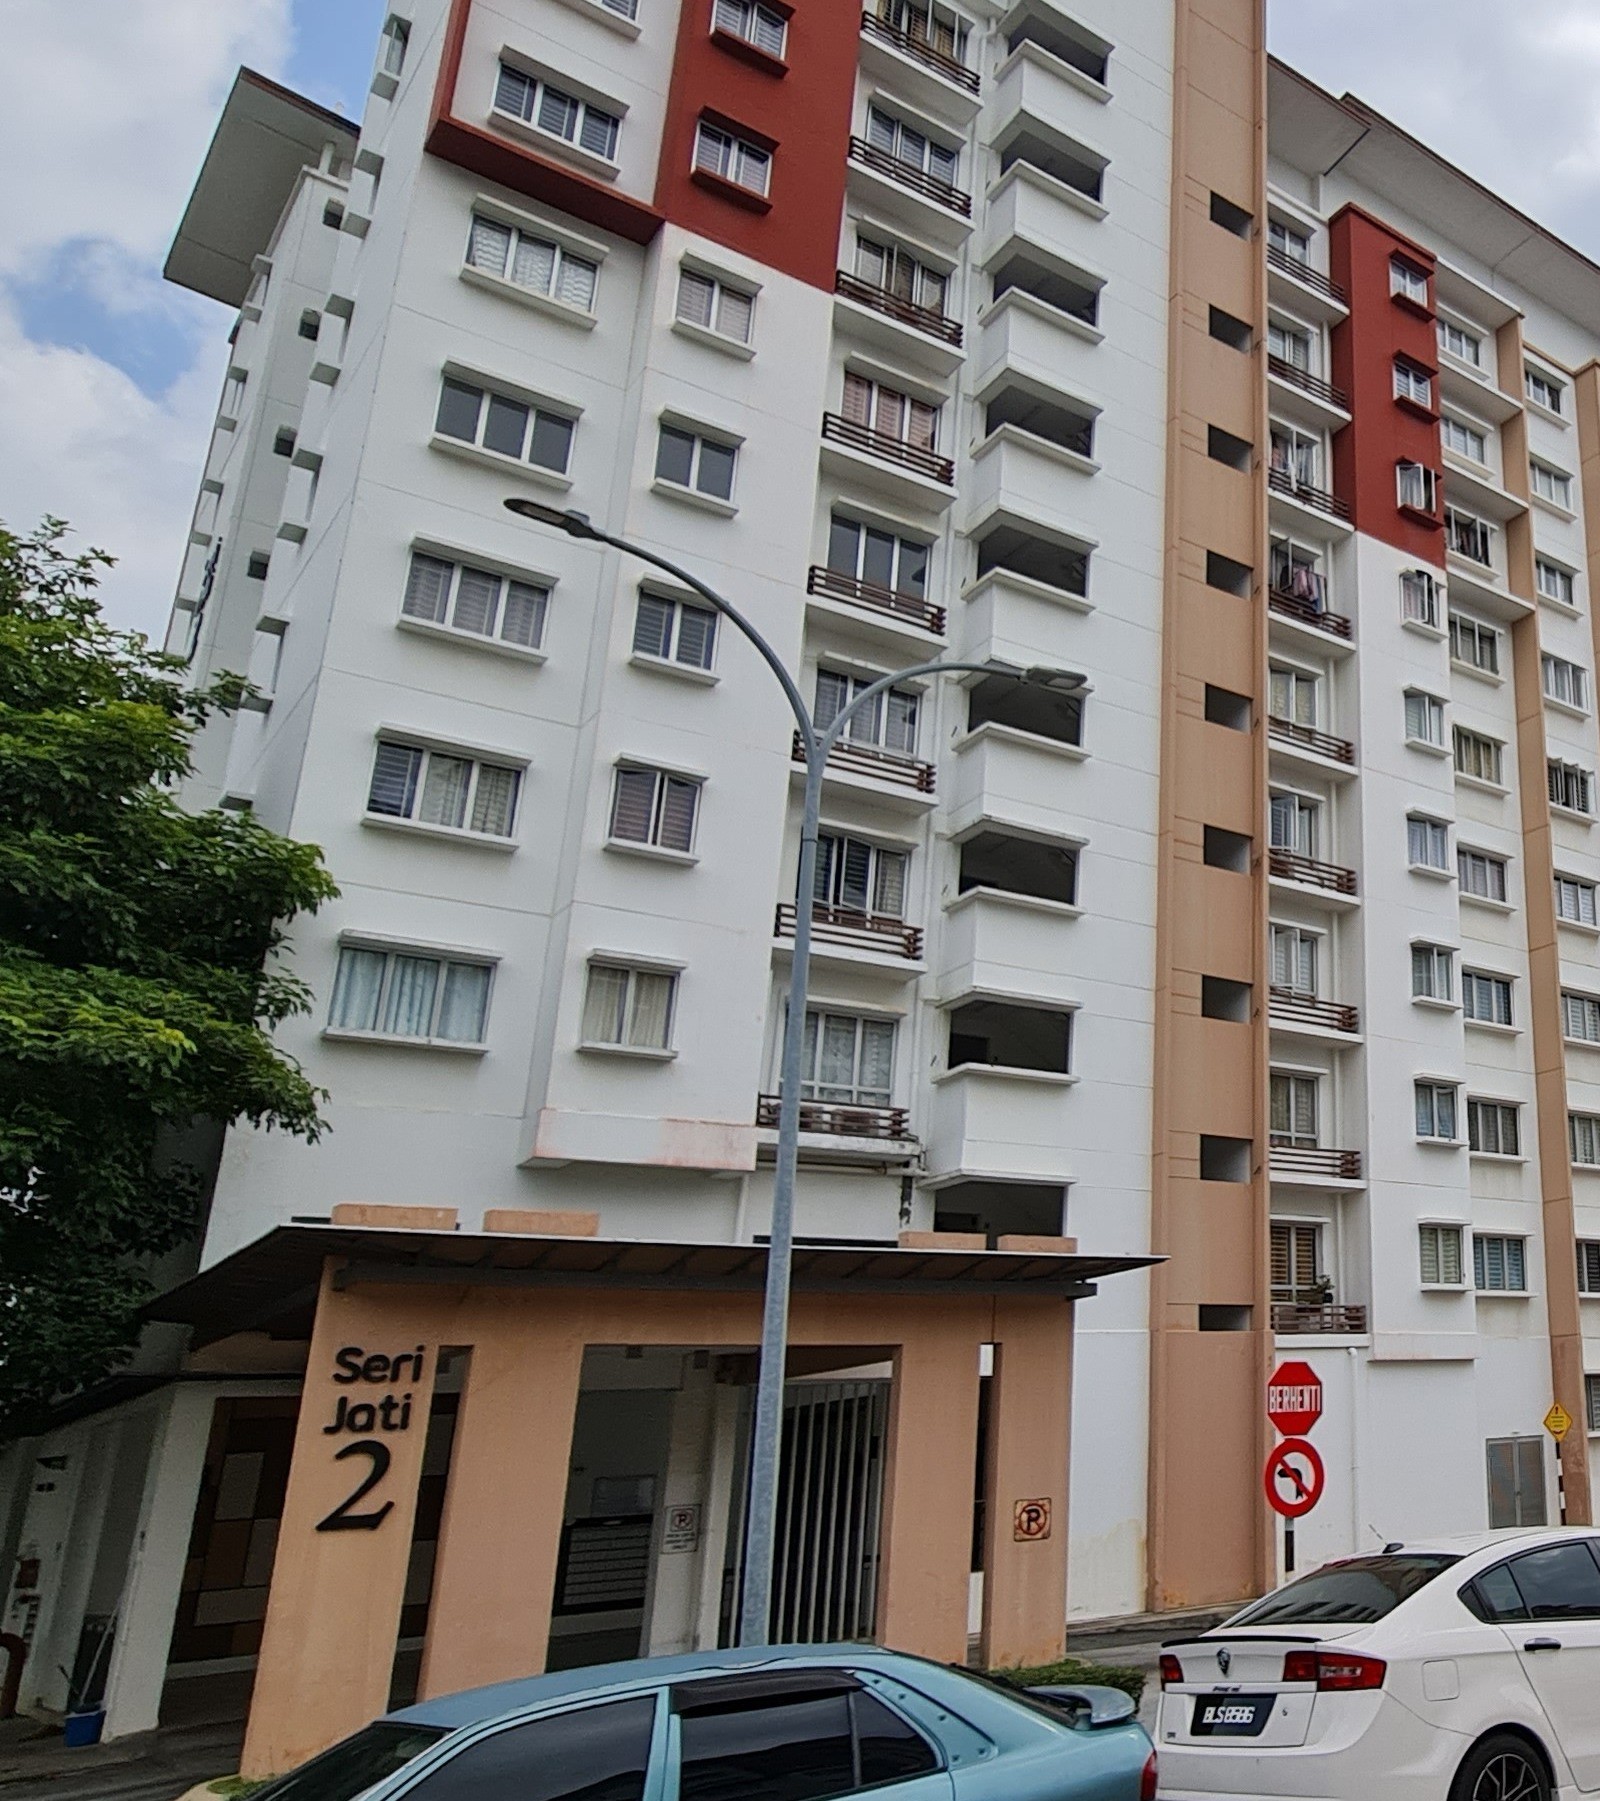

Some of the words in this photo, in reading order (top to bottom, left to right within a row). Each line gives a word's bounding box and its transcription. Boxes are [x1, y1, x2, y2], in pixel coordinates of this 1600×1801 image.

[333, 1345, 424, 1383] Seri
[322, 1393, 412, 1434] Jati
[1269, 1385, 1320, 1413] BERHENTI
[315, 1439, 395, 1531] 2
